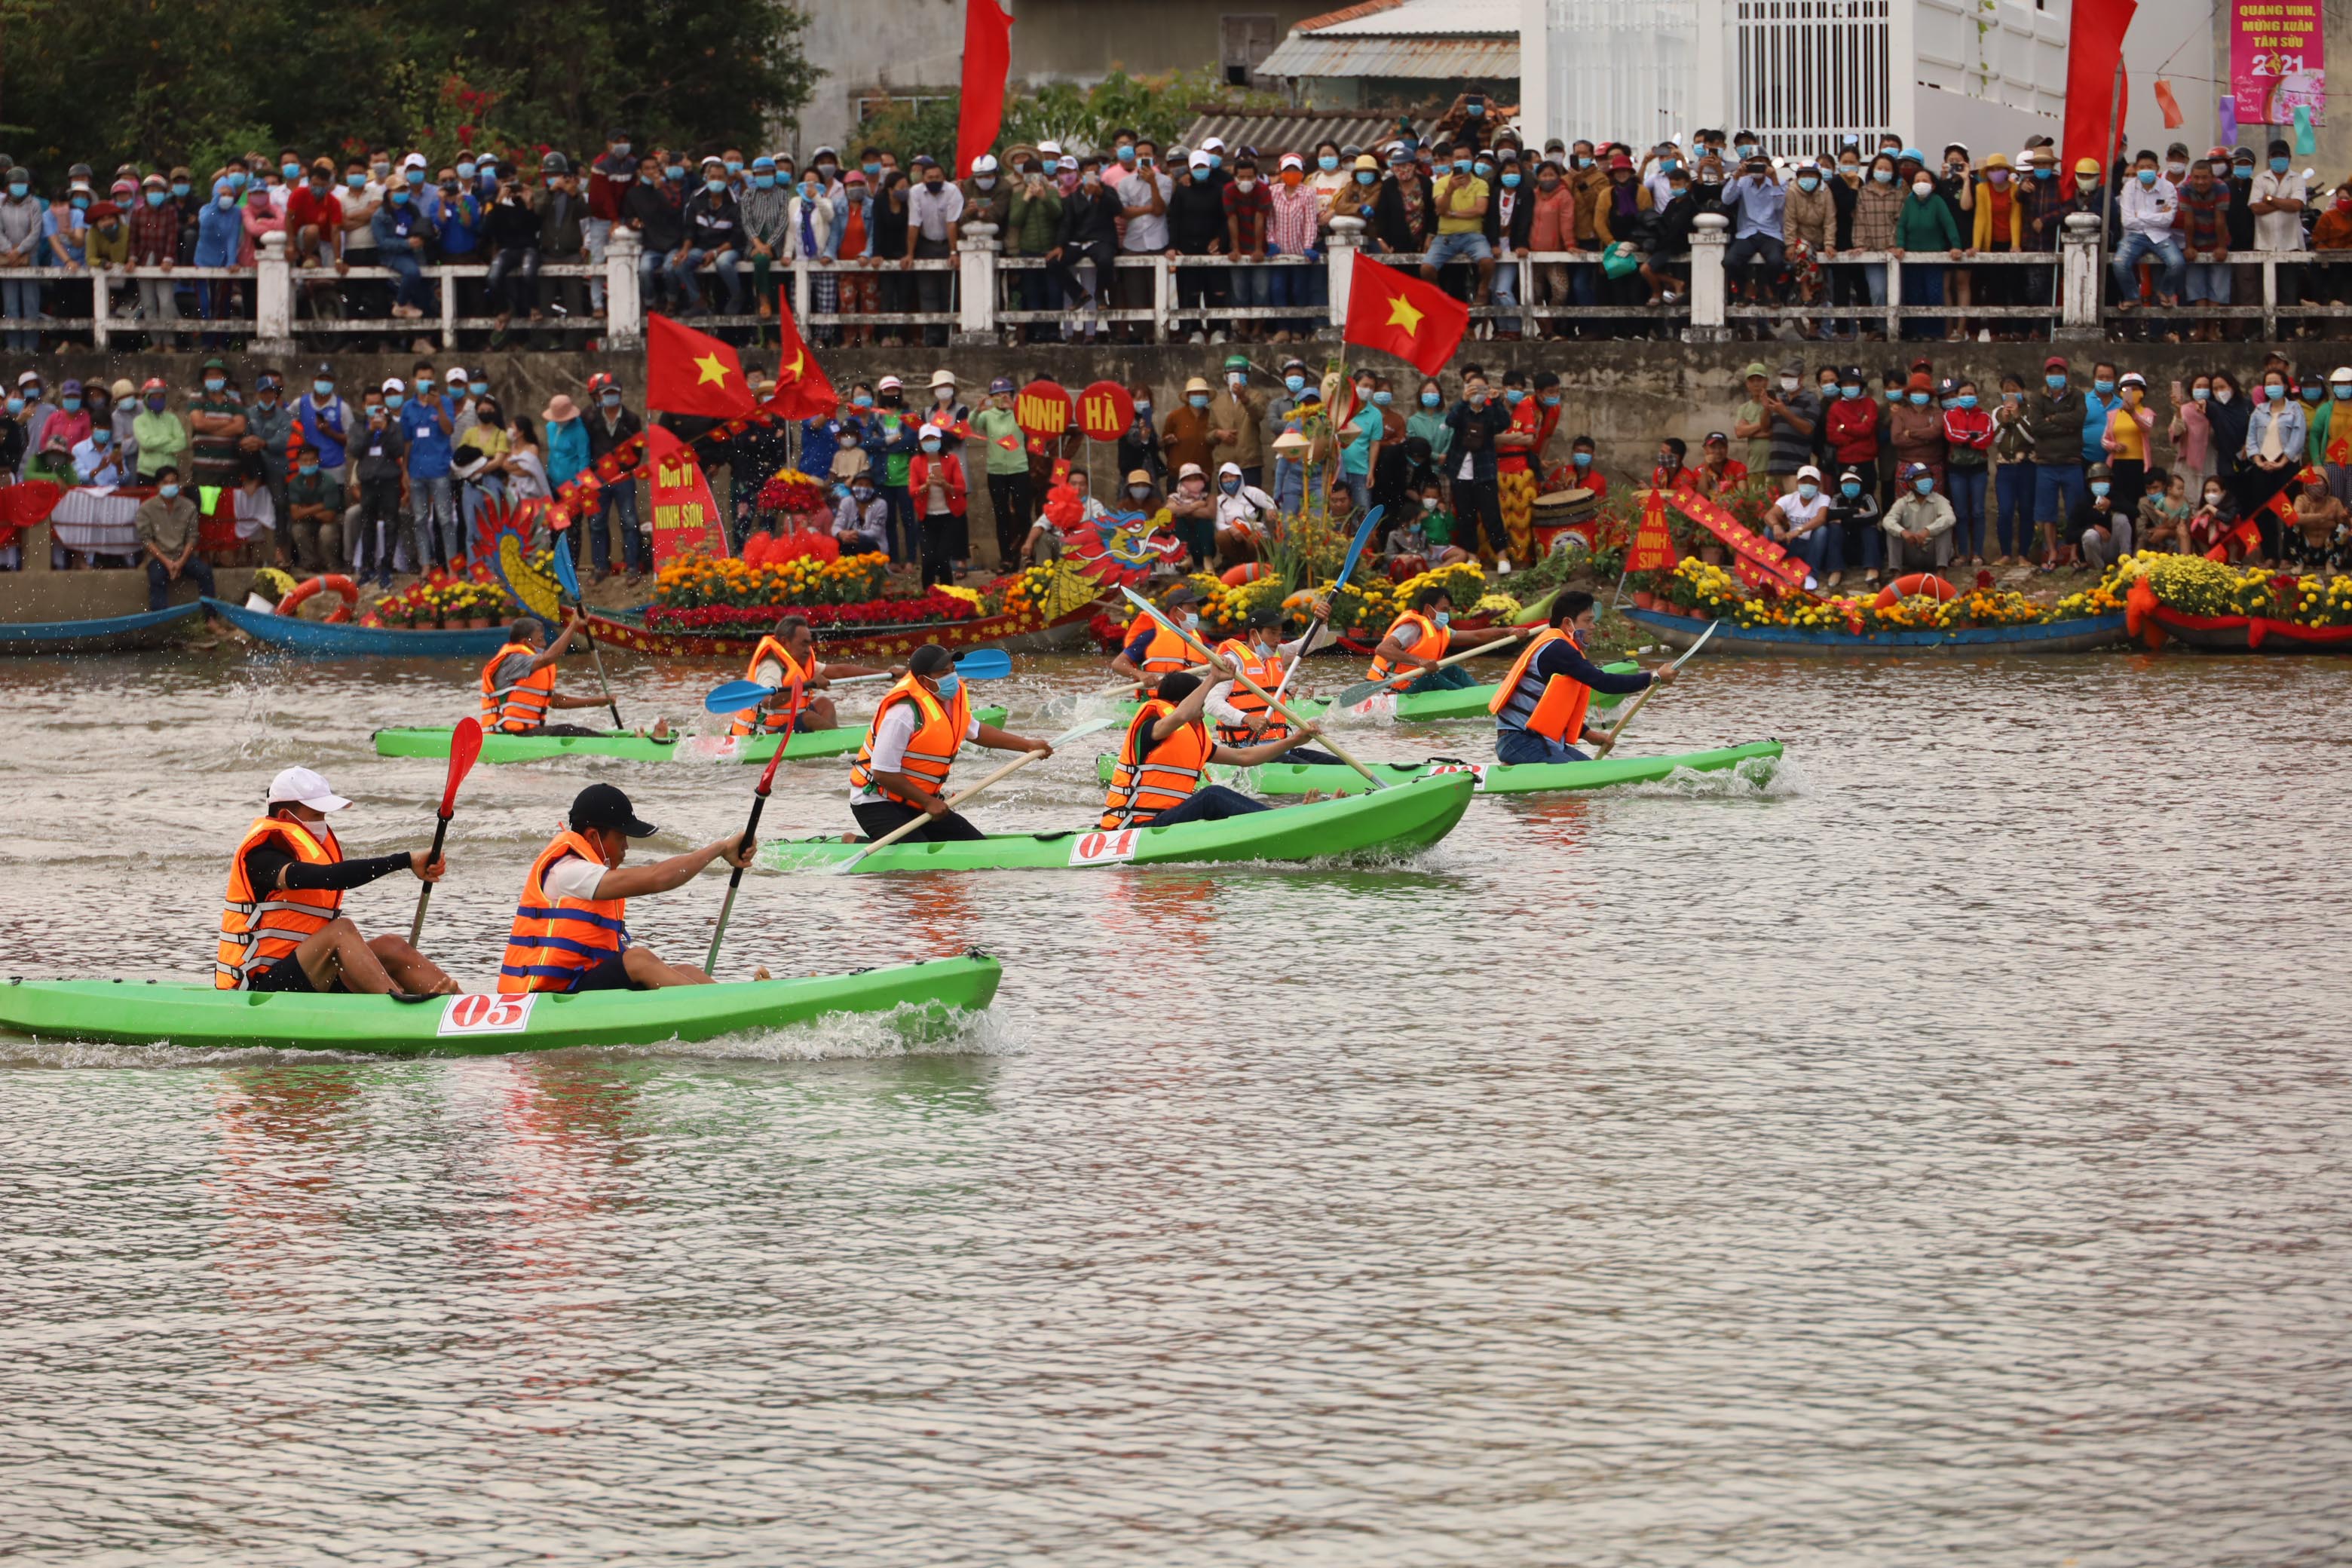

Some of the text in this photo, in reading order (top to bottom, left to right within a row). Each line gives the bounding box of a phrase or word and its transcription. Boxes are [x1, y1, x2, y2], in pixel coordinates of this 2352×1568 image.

[2240, 5, 2283, 17] QUANG
[2242, 19, 2314, 32] MỪNG XUÂN
[2252, 35, 2277, 47] TÂN
[1018, 392, 1119, 433] NINH HÀ
[655, 504, 680, 529] NINH
[1637, 531, 1668, 549] NINH
[1079, 829, 1133, 859] 04
[452, 994, 528, 1027] 05
